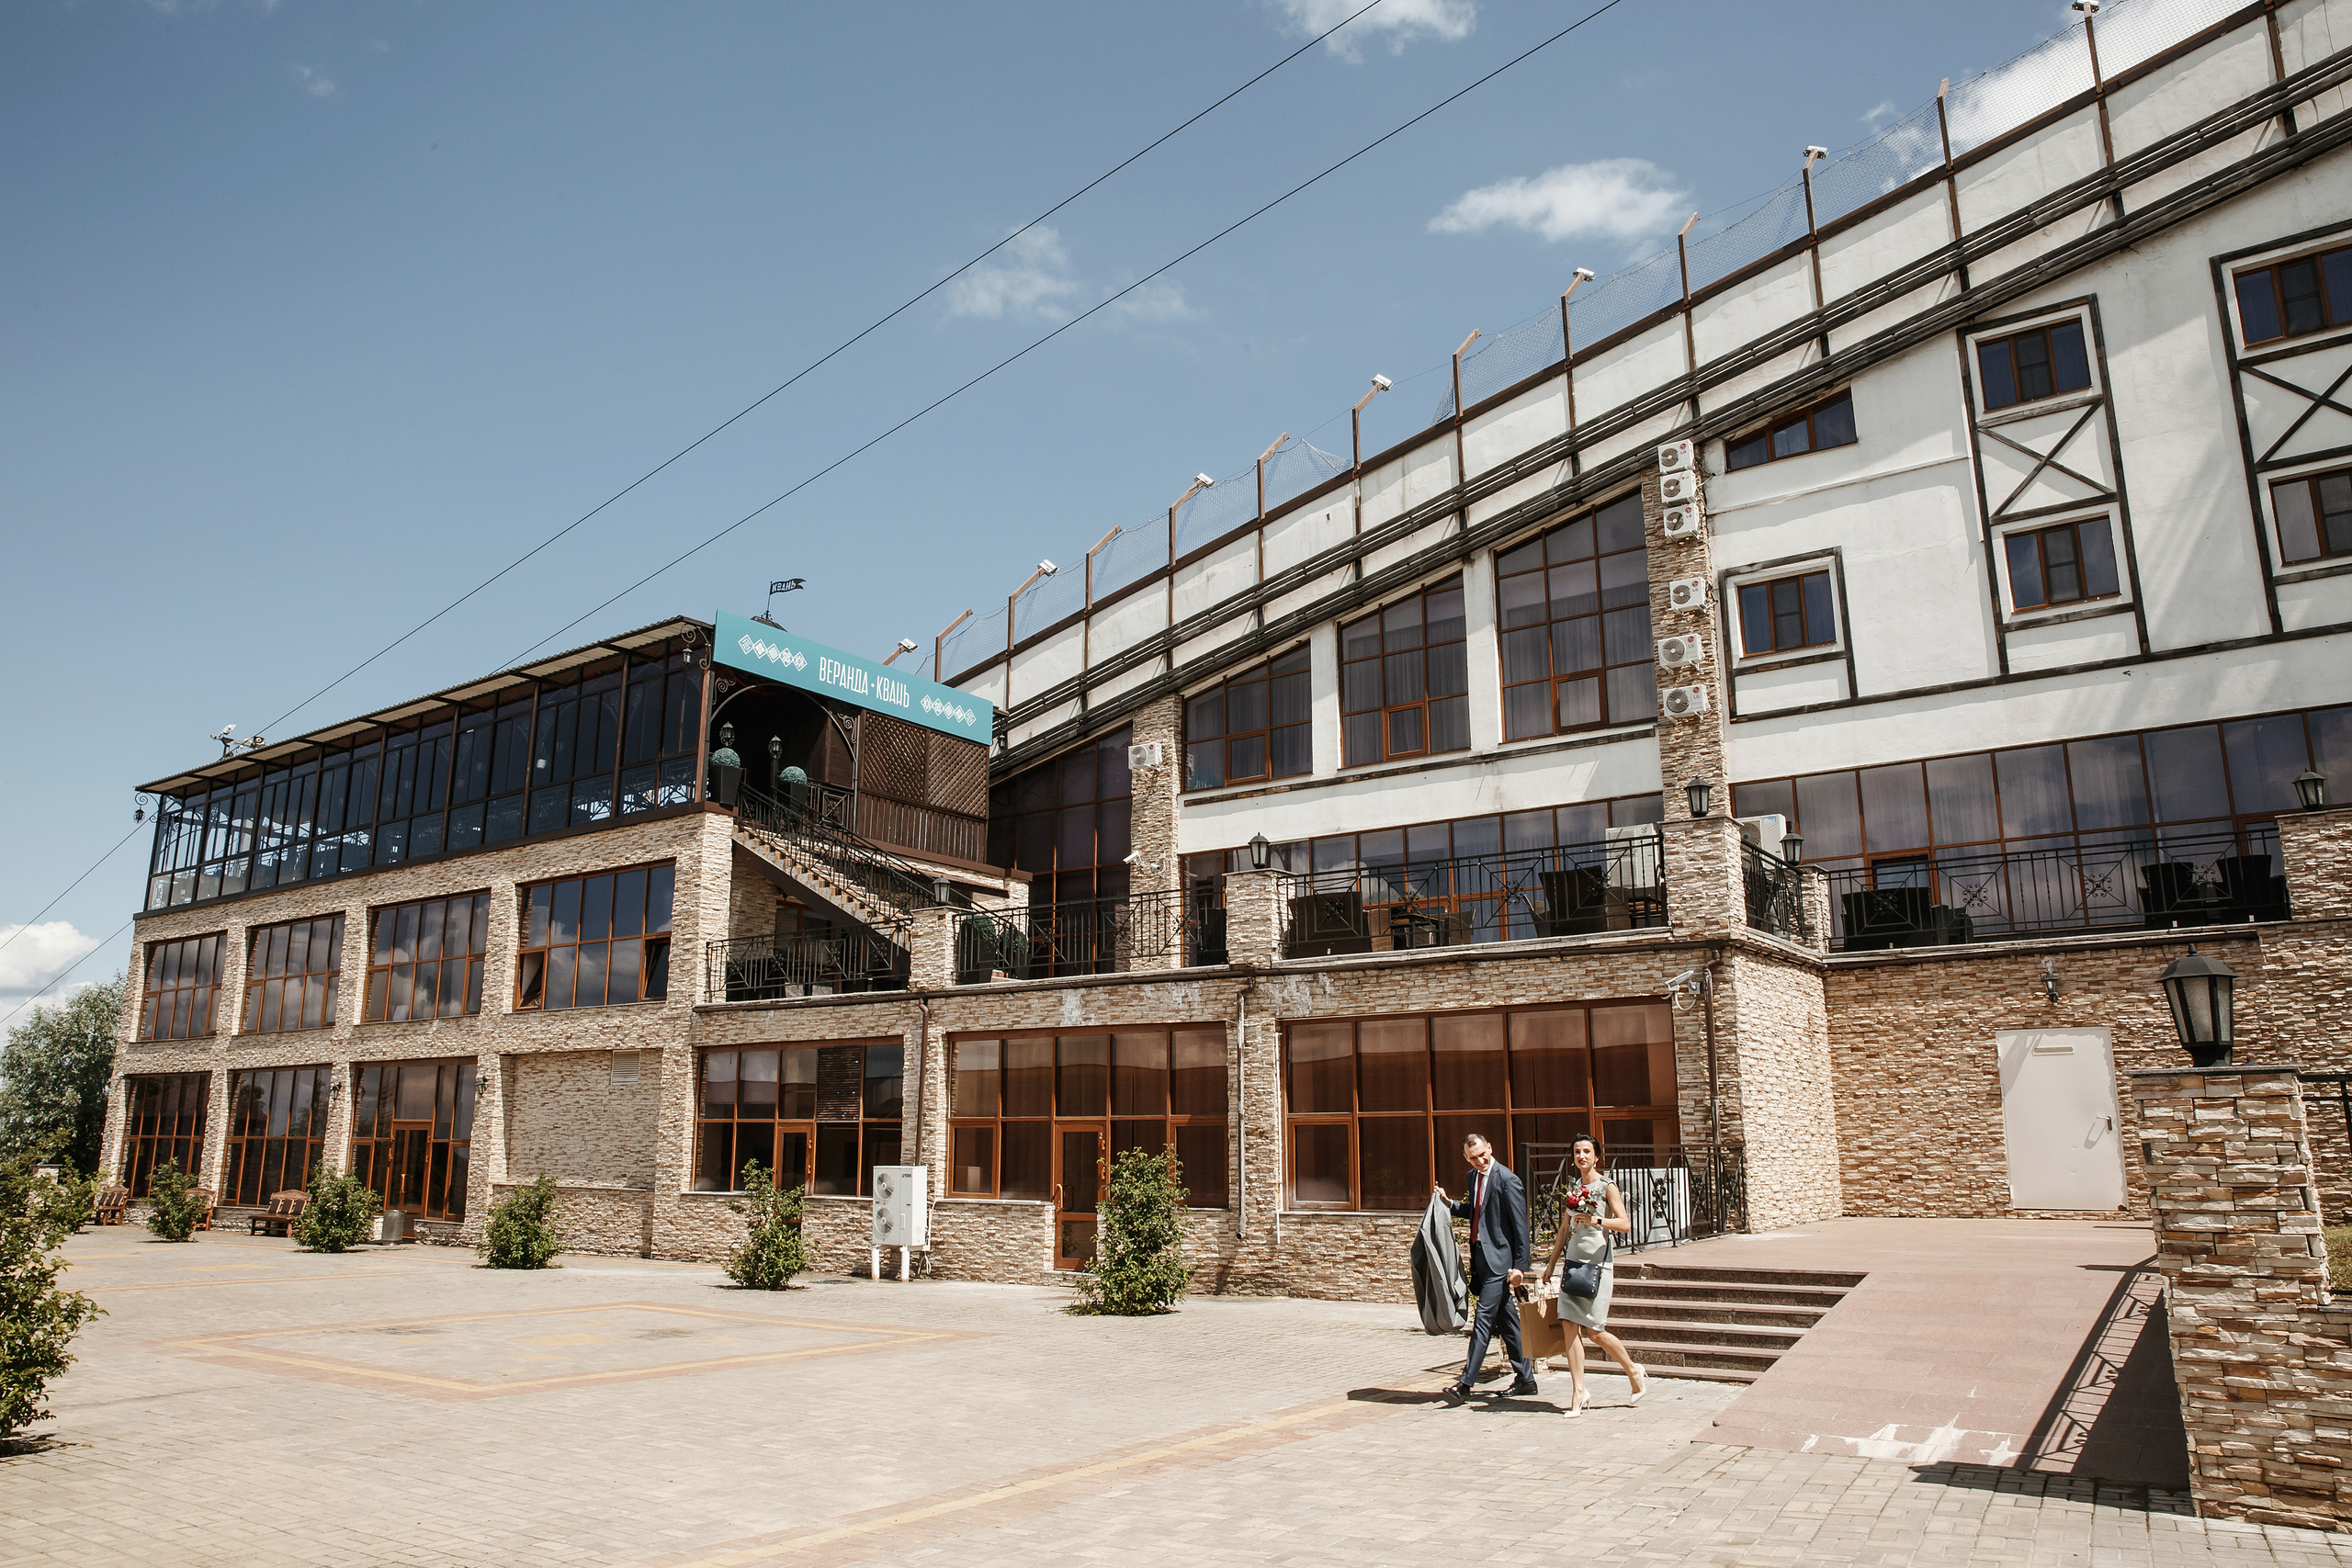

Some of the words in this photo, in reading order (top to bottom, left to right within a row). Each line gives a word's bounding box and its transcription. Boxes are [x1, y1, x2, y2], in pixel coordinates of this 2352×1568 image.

[772, 581, 797, 593] КВАНЬ
[819, 656, 869, 696] ВЕРАНДА
[876, 675, 910, 708] КВАНЬ
